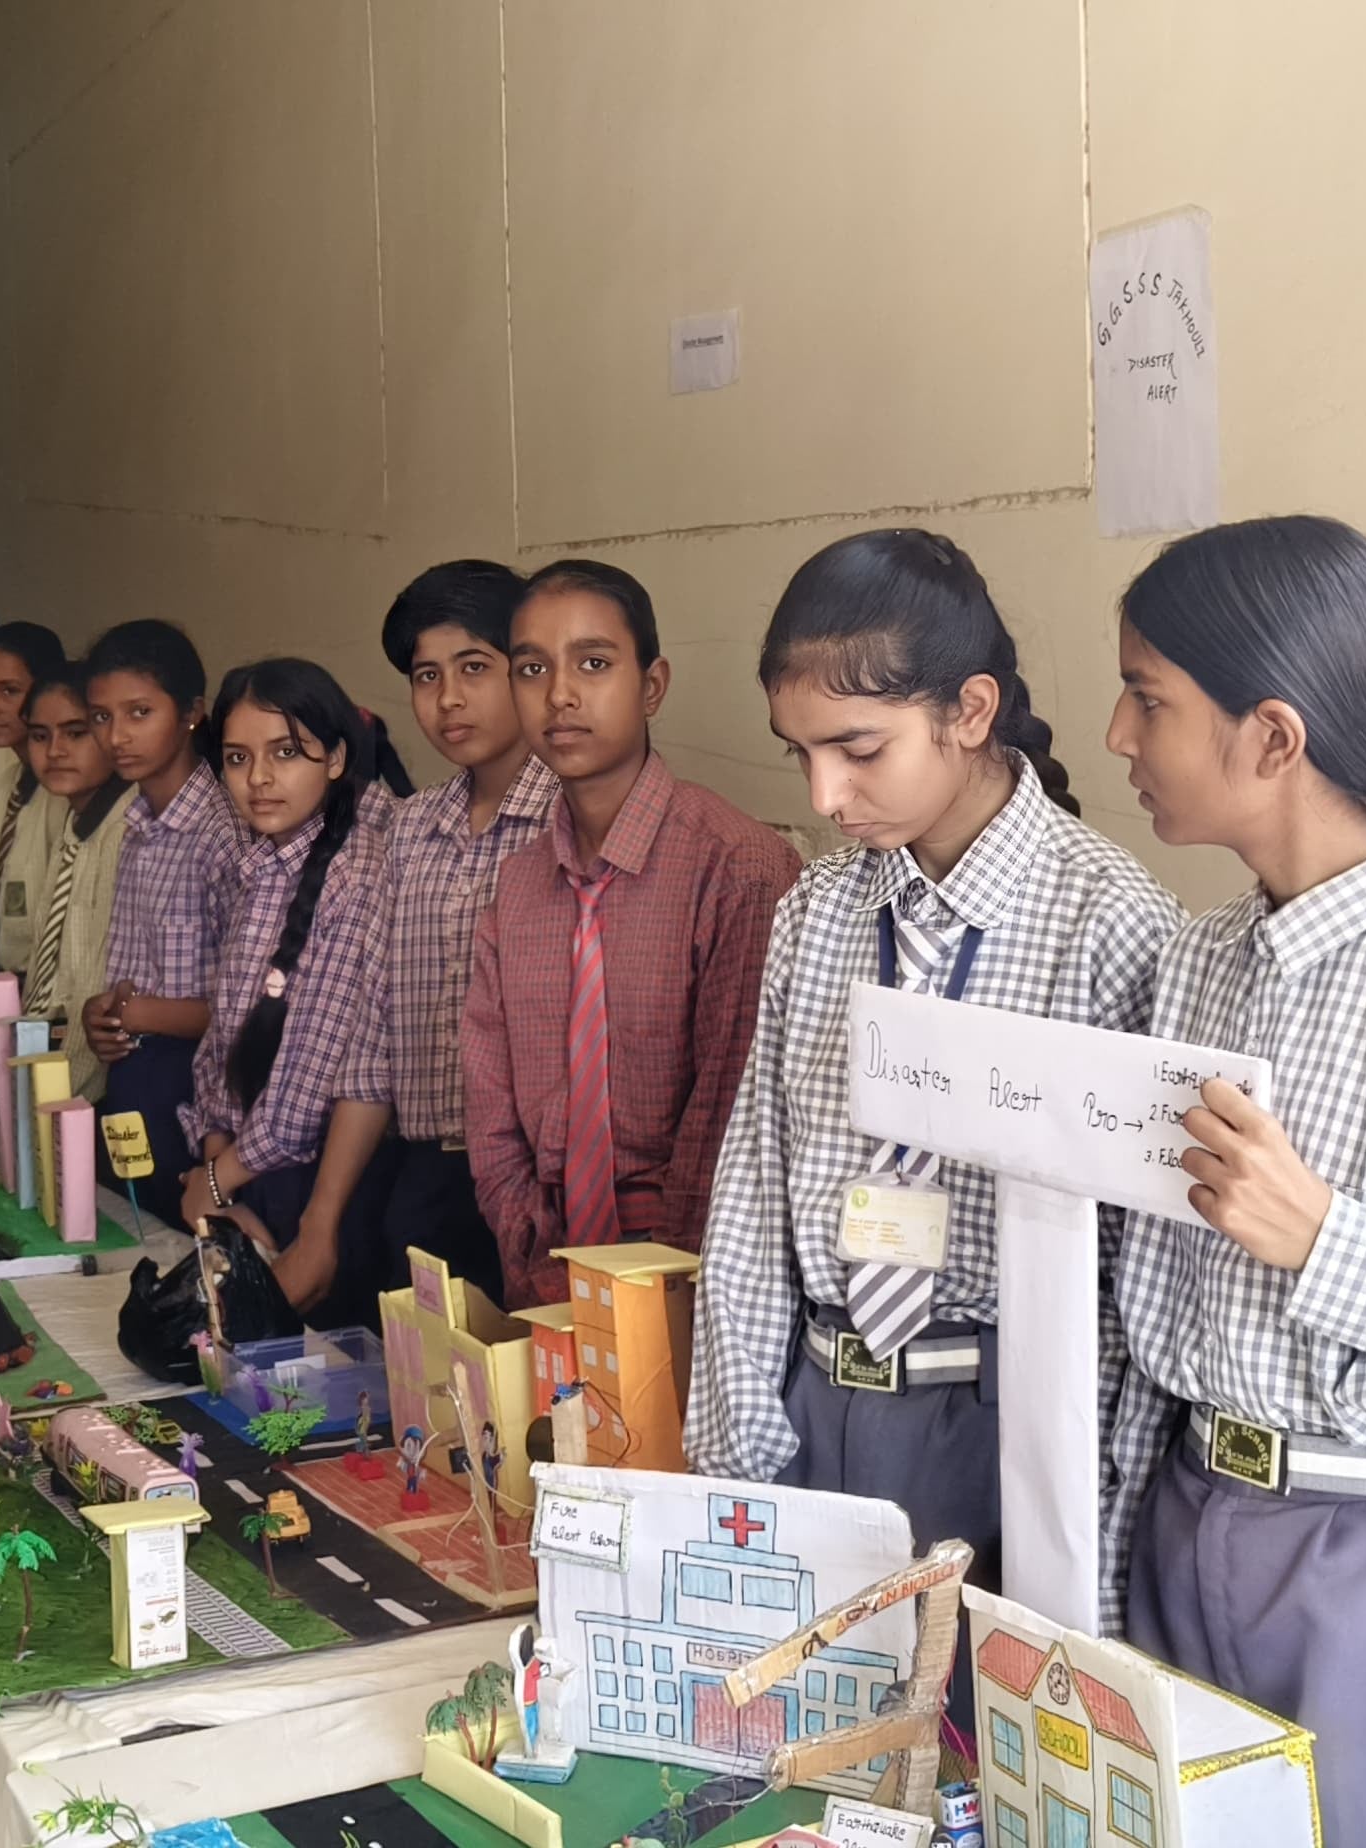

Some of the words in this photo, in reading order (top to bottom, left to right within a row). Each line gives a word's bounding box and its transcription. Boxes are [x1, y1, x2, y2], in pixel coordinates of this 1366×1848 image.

[1128, 352, 1177, 380] DISASTER
[1146, 384, 1177, 404] ALERT
[864, 1020, 951, 1096] Disaster
[989, 1066, 1043, 1113] Alert
[550, 1501, 578, 1519] Fire
[551, 1525, 582, 1542] Alert
[1039, 1714, 1085, 1759] SCHOOL
